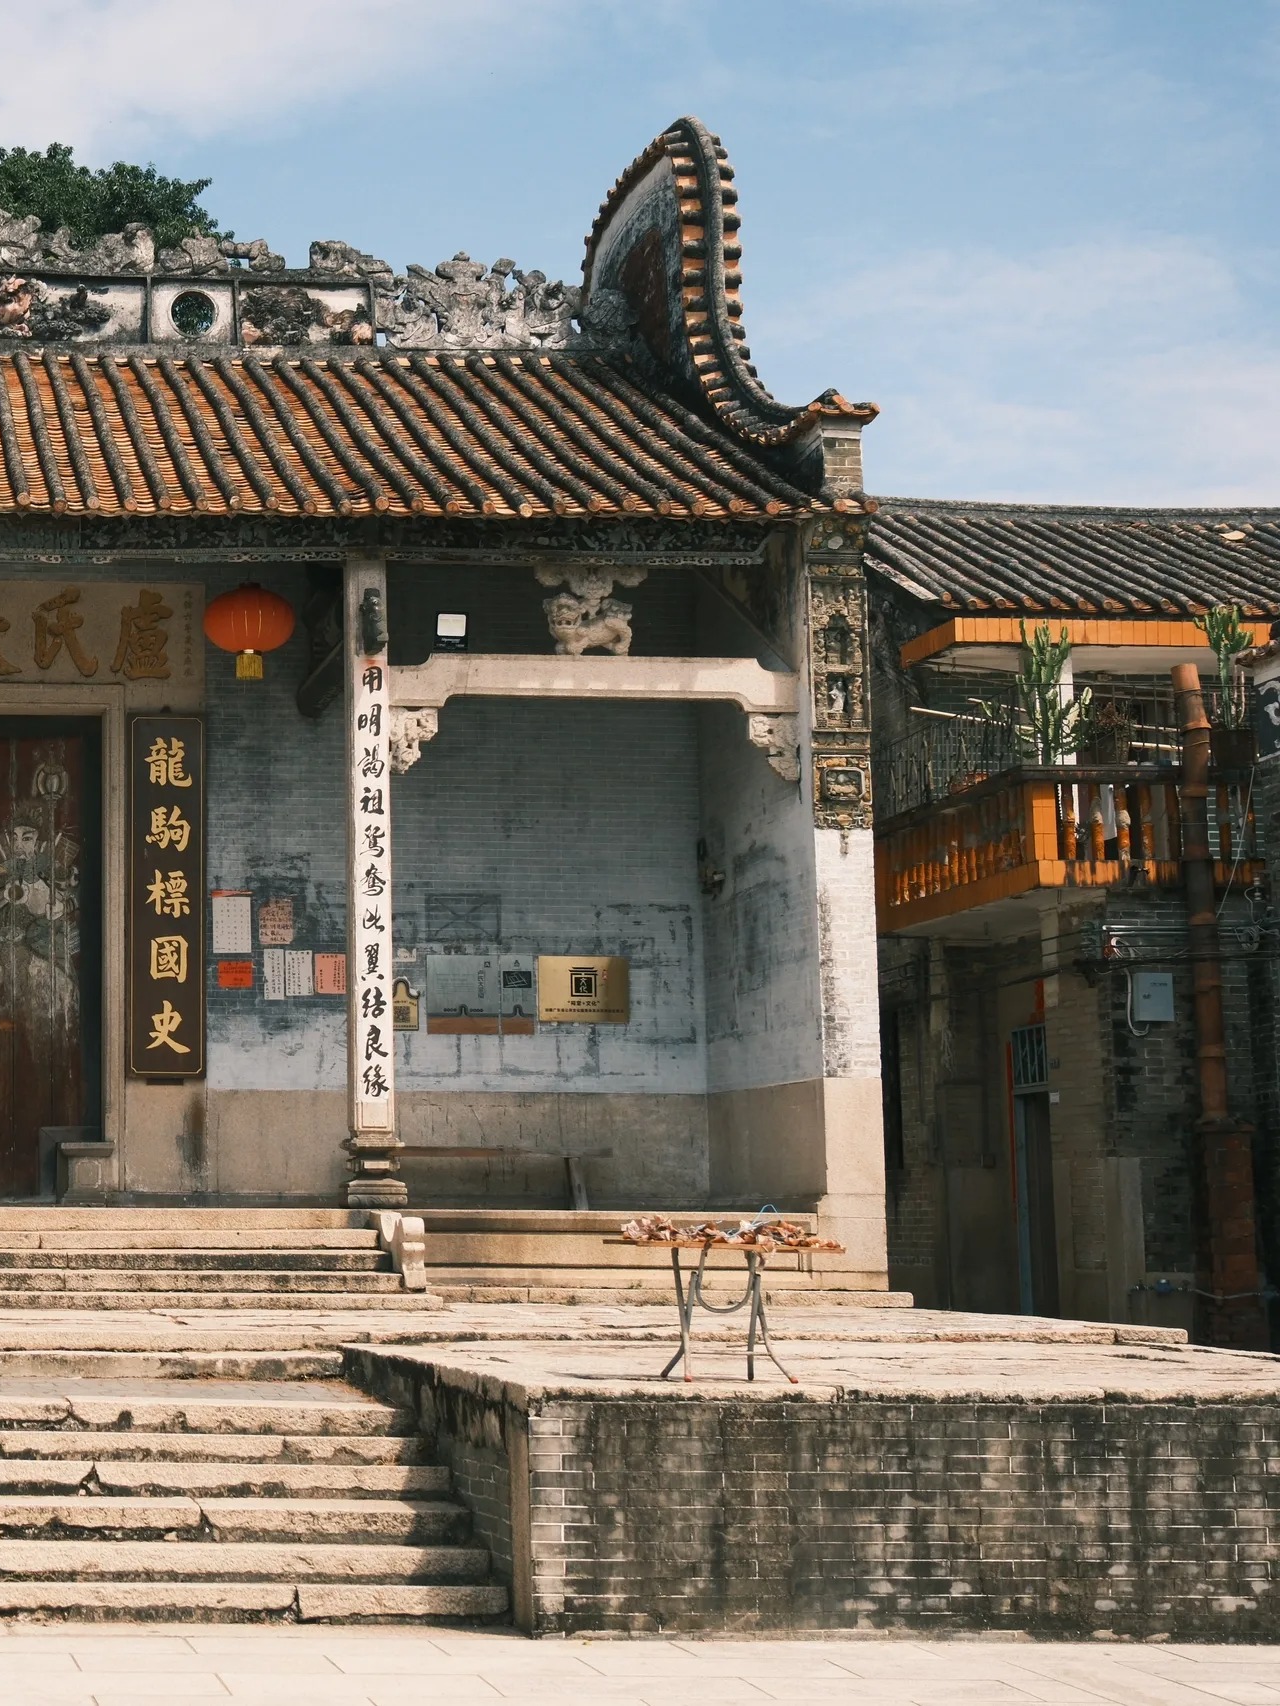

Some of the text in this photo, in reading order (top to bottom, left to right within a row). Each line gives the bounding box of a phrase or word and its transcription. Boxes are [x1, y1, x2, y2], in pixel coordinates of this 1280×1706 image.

[144, 737, 193, 1055] 龍駒標國史
